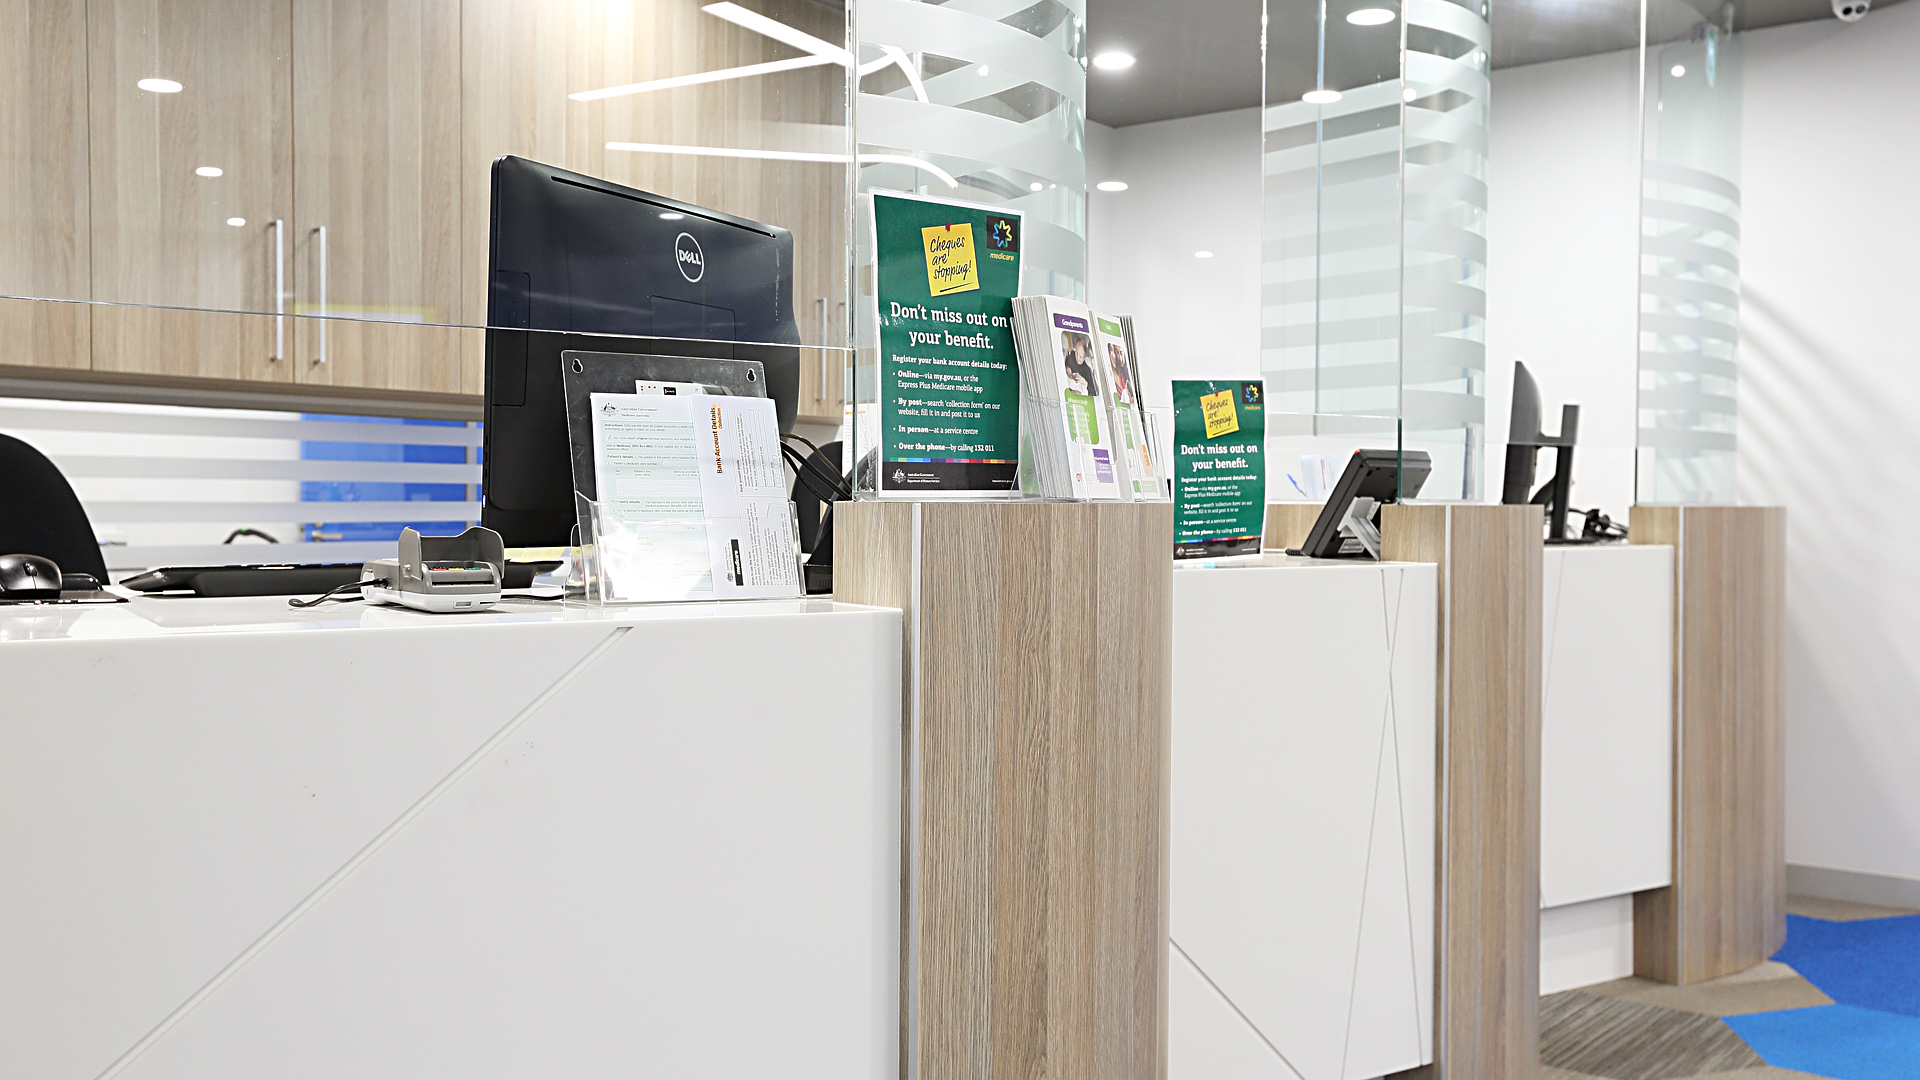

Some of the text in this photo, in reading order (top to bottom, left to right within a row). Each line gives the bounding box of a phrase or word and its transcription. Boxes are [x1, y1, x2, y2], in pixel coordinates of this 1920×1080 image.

[930, 236, 965, 256] Cheques
[679, 250, 701, 265] DELL
[932, 254, 948, 265] are
[990, 252, 1015, 261] medicare
[933, 260, 972, 282] stopping!
[890, 302, 1008, 327] Don't miss out on
[909, 330, 994, 349] your benefit.
[892, 354, 917, 364] Register
[918, 357, 932, 365] your
[933, 357, 947, 365] bank
[971, 360, 990, 368] details
[898, 380, 918, 390] Express
[932, 382, 955, 390] Medicare
[898, 398, 907, 406] By
[898, 408, 920, 416] website,
[898, 425, 906, 433] In
[712, 431, 720, 456] Account
[957, 444, 974, 453] calling
[1181, 444, 1258, 454] Don't miss out on
[1192, 458, 1248, 472] your benefit.
